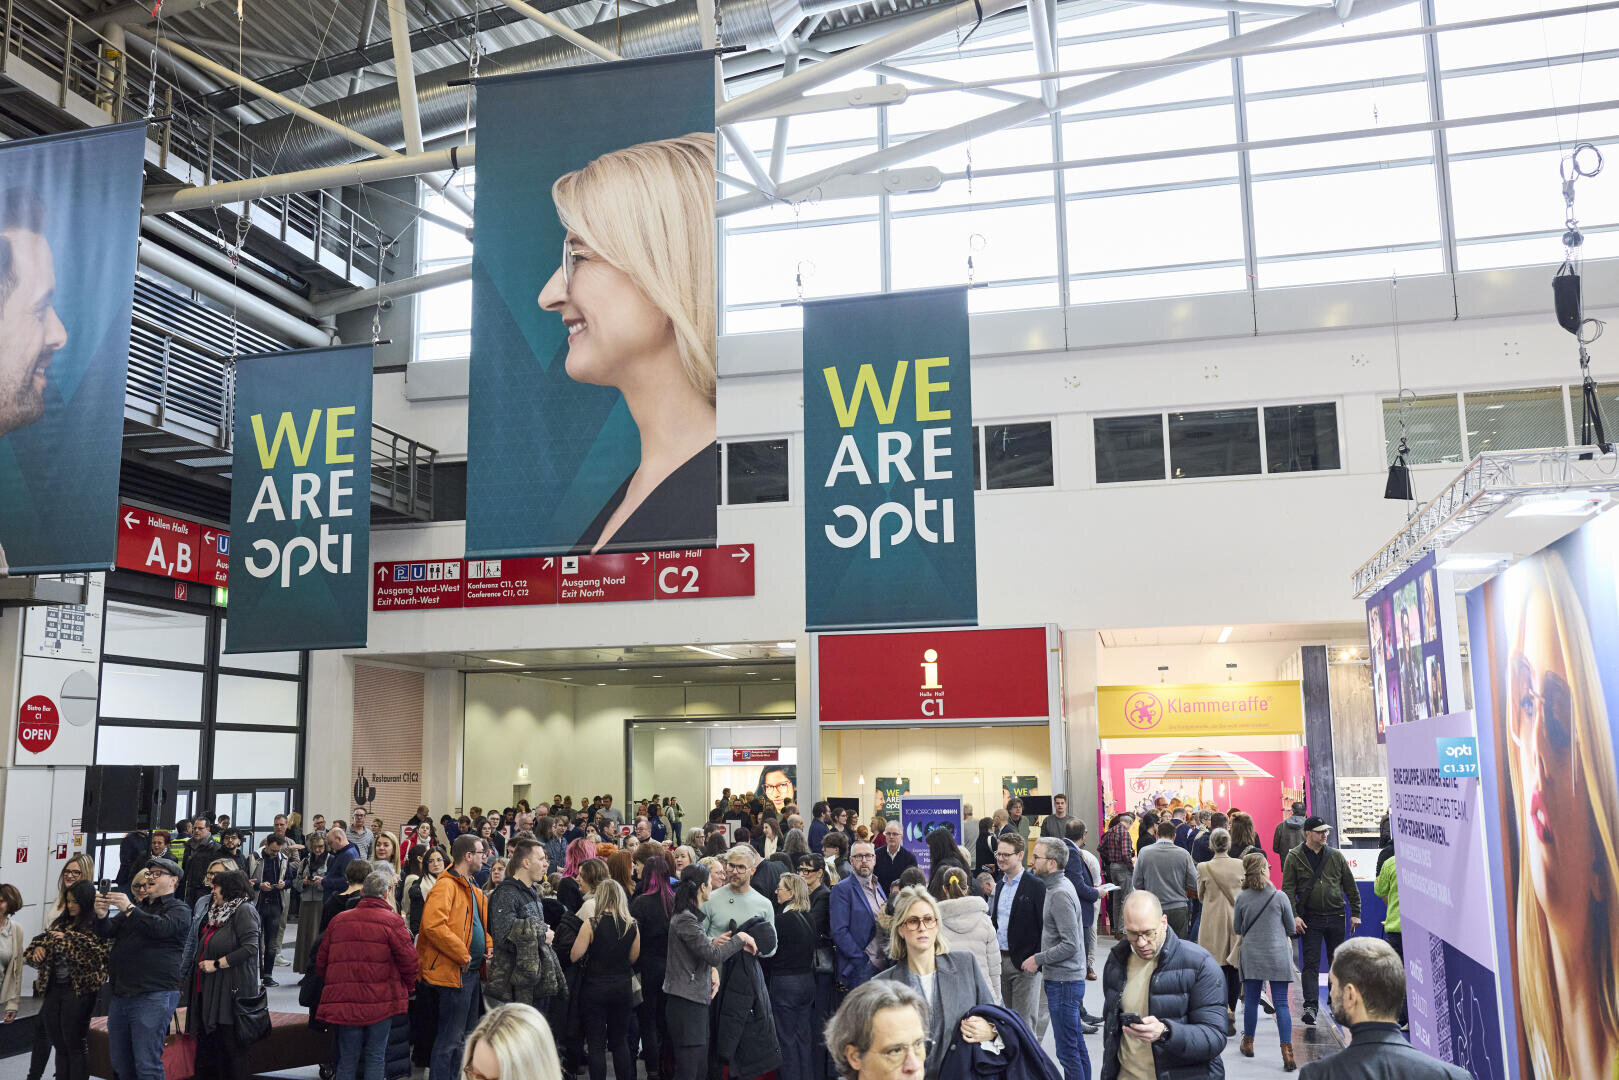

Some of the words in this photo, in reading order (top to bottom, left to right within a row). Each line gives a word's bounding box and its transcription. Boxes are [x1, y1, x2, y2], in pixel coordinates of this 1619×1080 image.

[823, 356, 951, 428] WE
[250, 406, 356, 470] WE
[824, 427, 952, 488] ARE
[246, 470, 354, 522] ARE
[148, 516, 170, 531] Hallen
[172, 522, 188, 534] Halls
[824, 488, 954, 559] opti
[145, 536, 192, 576] A,B
[244, 524, 352, 588] opti
[658, 551, 680, 559] Halle
[685, 549, 702, 558] Hall
[216, 558, 229, 569] Aus
[216, 572, 226, 582] Exit
[562, 578, 600, 588] Ausgang
[602, 576, 626, 584] Nord
[658, 566, 700, 594] C2
[378, 587, 414, 596] Ausgang
[416, 584, 460, 593] Nord-West
[562, 589, 577, 598] Exit
[580, 588, 604, 597] North
[394, 596, 440, 605] North-West
[921, 698, 944, 716] C1
[22, 728, 52, 740] OPEN
[1443, 764, 1476, 773] C1.317
[372, 774, 402, 782] Restaurant
